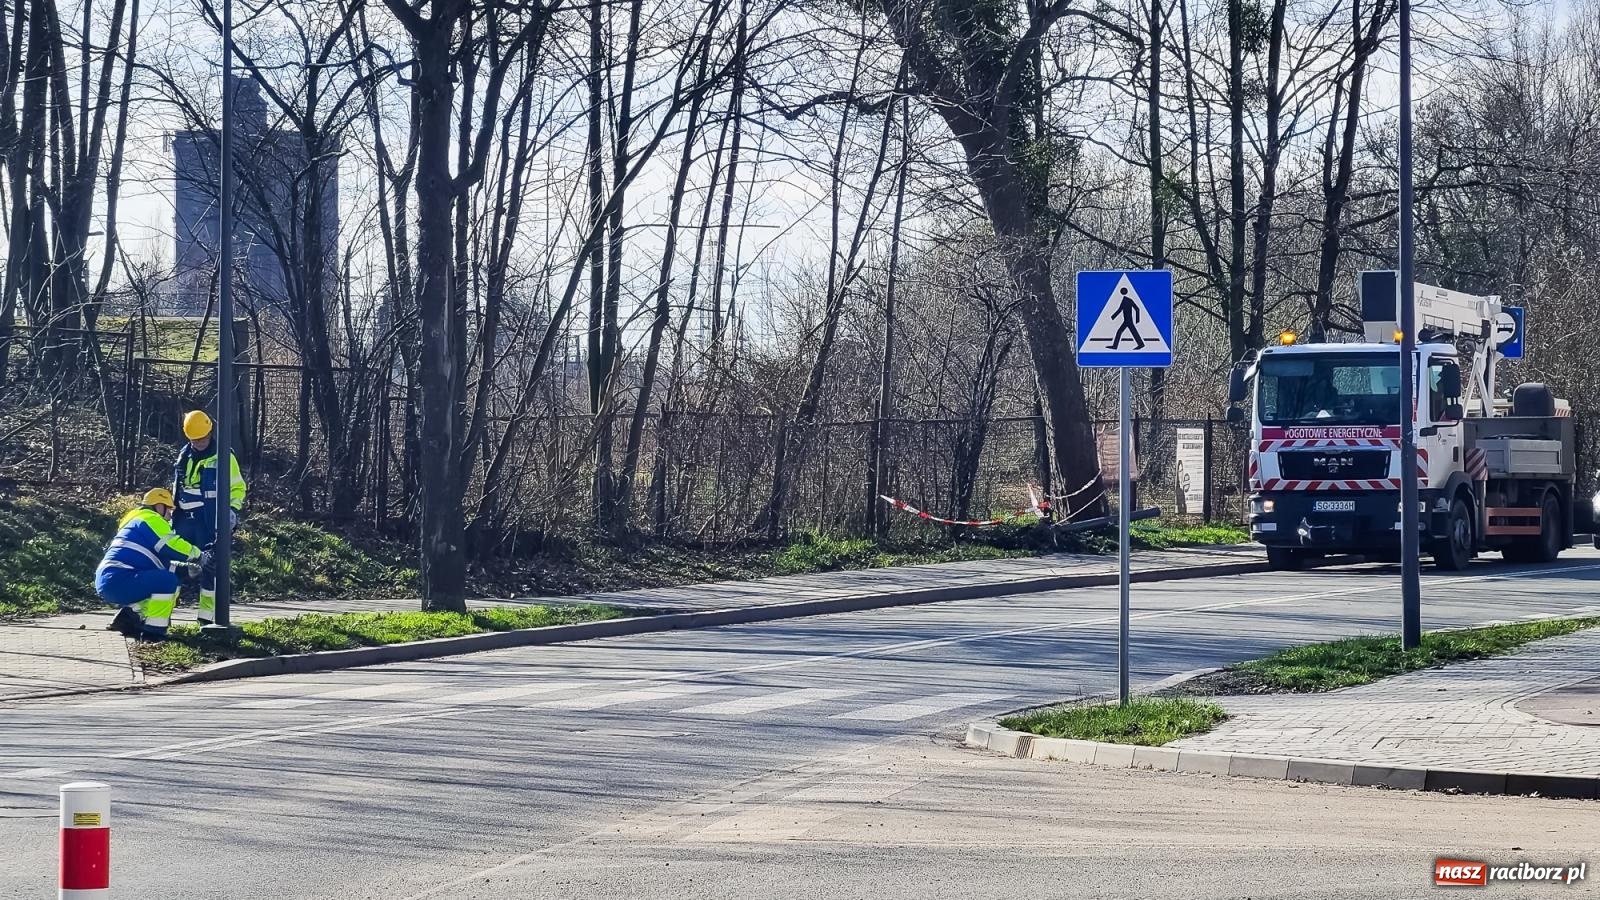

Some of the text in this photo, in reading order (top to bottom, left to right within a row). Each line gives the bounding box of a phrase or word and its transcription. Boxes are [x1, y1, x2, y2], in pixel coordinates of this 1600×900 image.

[1284, 428, 1383, 438] POGOTOWIE ENERGETYCZNE
[1313, 457, 1354, 466] MAN
